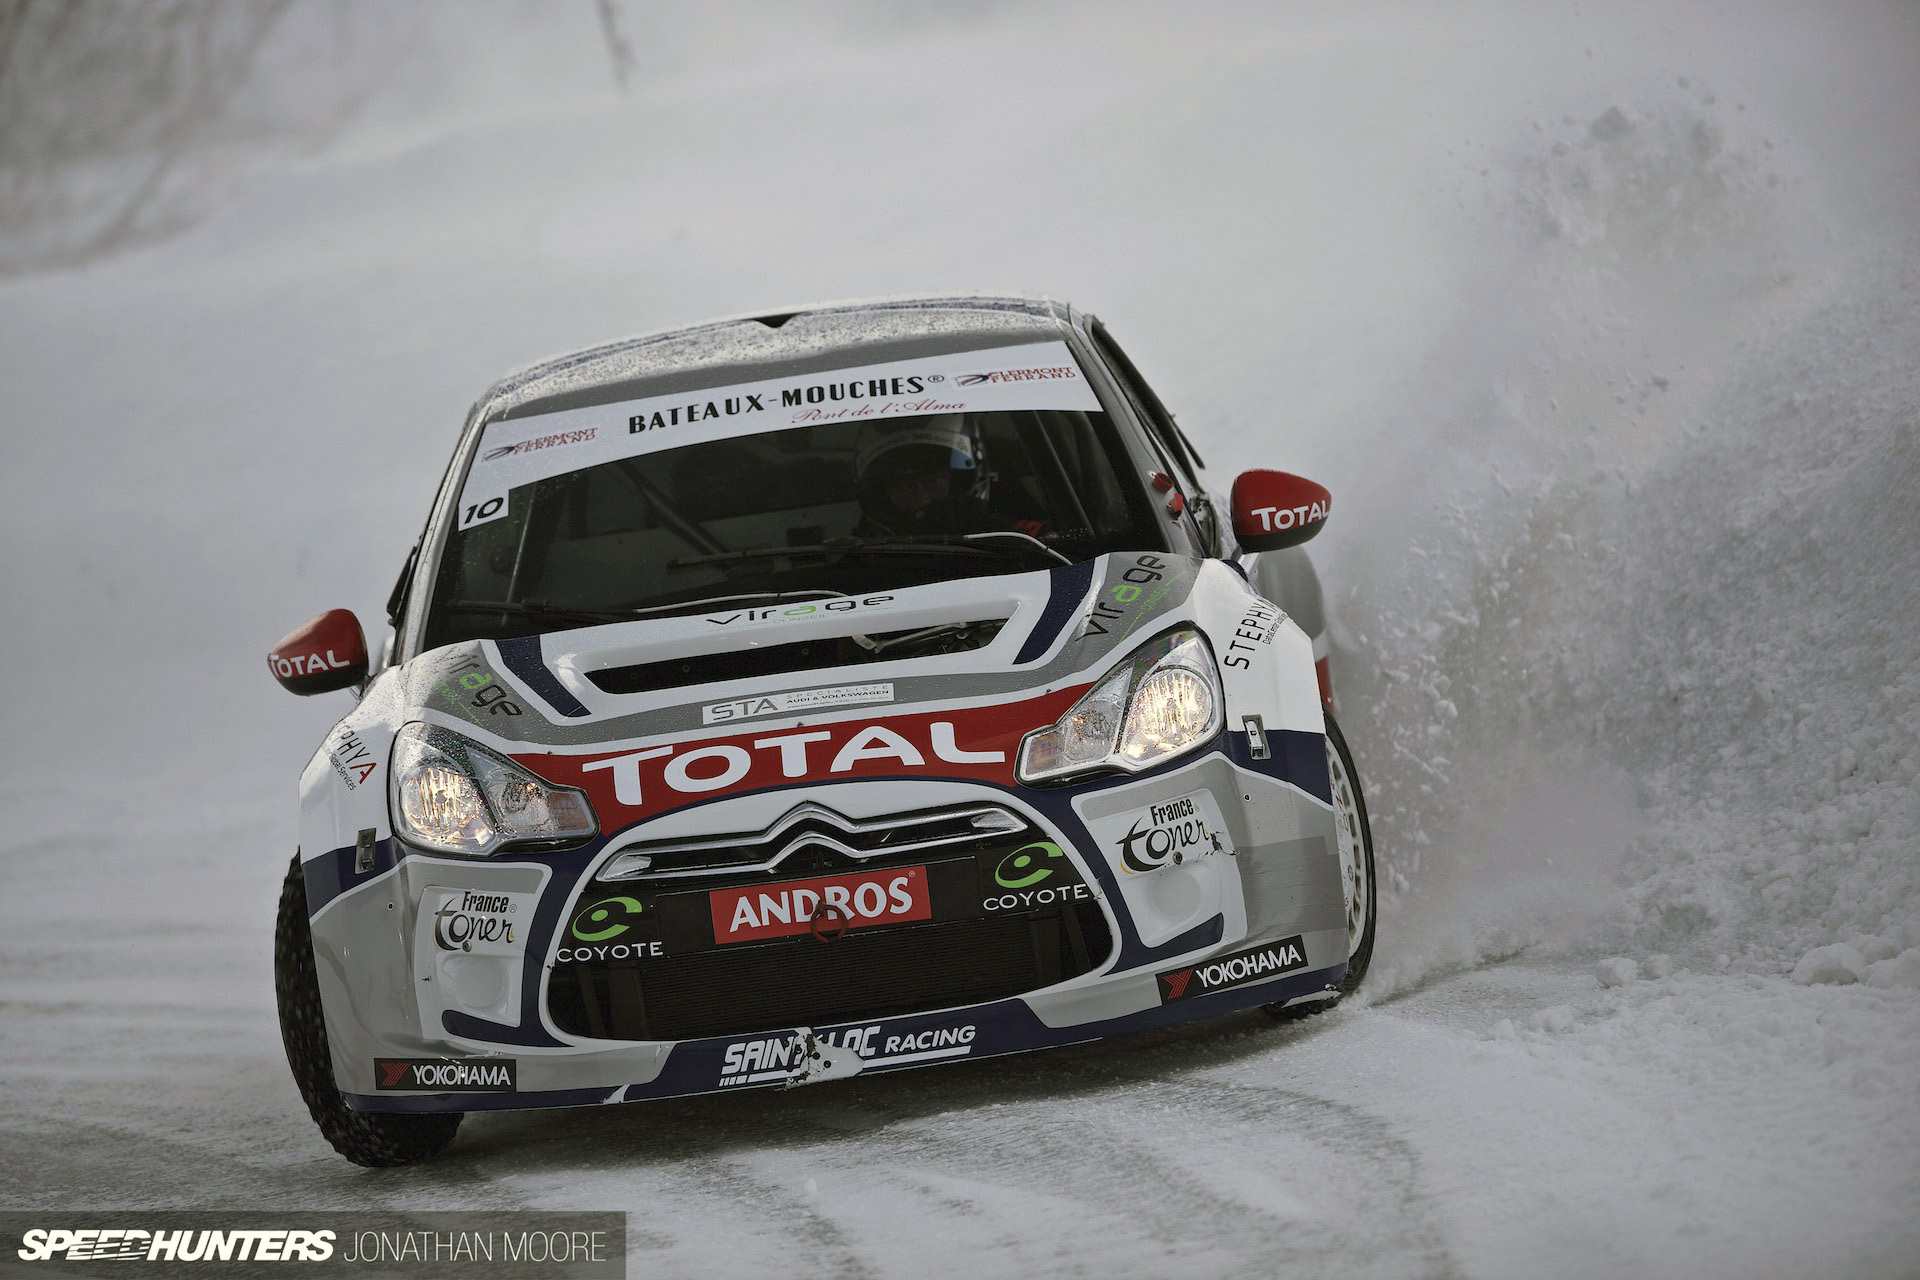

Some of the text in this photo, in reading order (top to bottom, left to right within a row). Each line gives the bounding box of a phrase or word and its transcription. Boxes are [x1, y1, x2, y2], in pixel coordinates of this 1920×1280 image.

[988, 366, 1072, 377] CLERMONT
[991, 372, 1076, 383] FERRAND
[851, 404, 874, 417] de
[515, 427, 598, 449] CLERMONT
[464, 497, 504, 525] 10
[822, 690, 890, 699] VOLKSWAGEN
[711, 698, 779, 721] STA
[983, 884, 1089, 912] COYOTE
[556, 941, 664, 963] COYOTE
[1195, 944, 1302, 989] YOKOHAMA
[884, 1024, 976, 1054] RACING
[411, 1064, 512, 1086] YOKOHAMA
